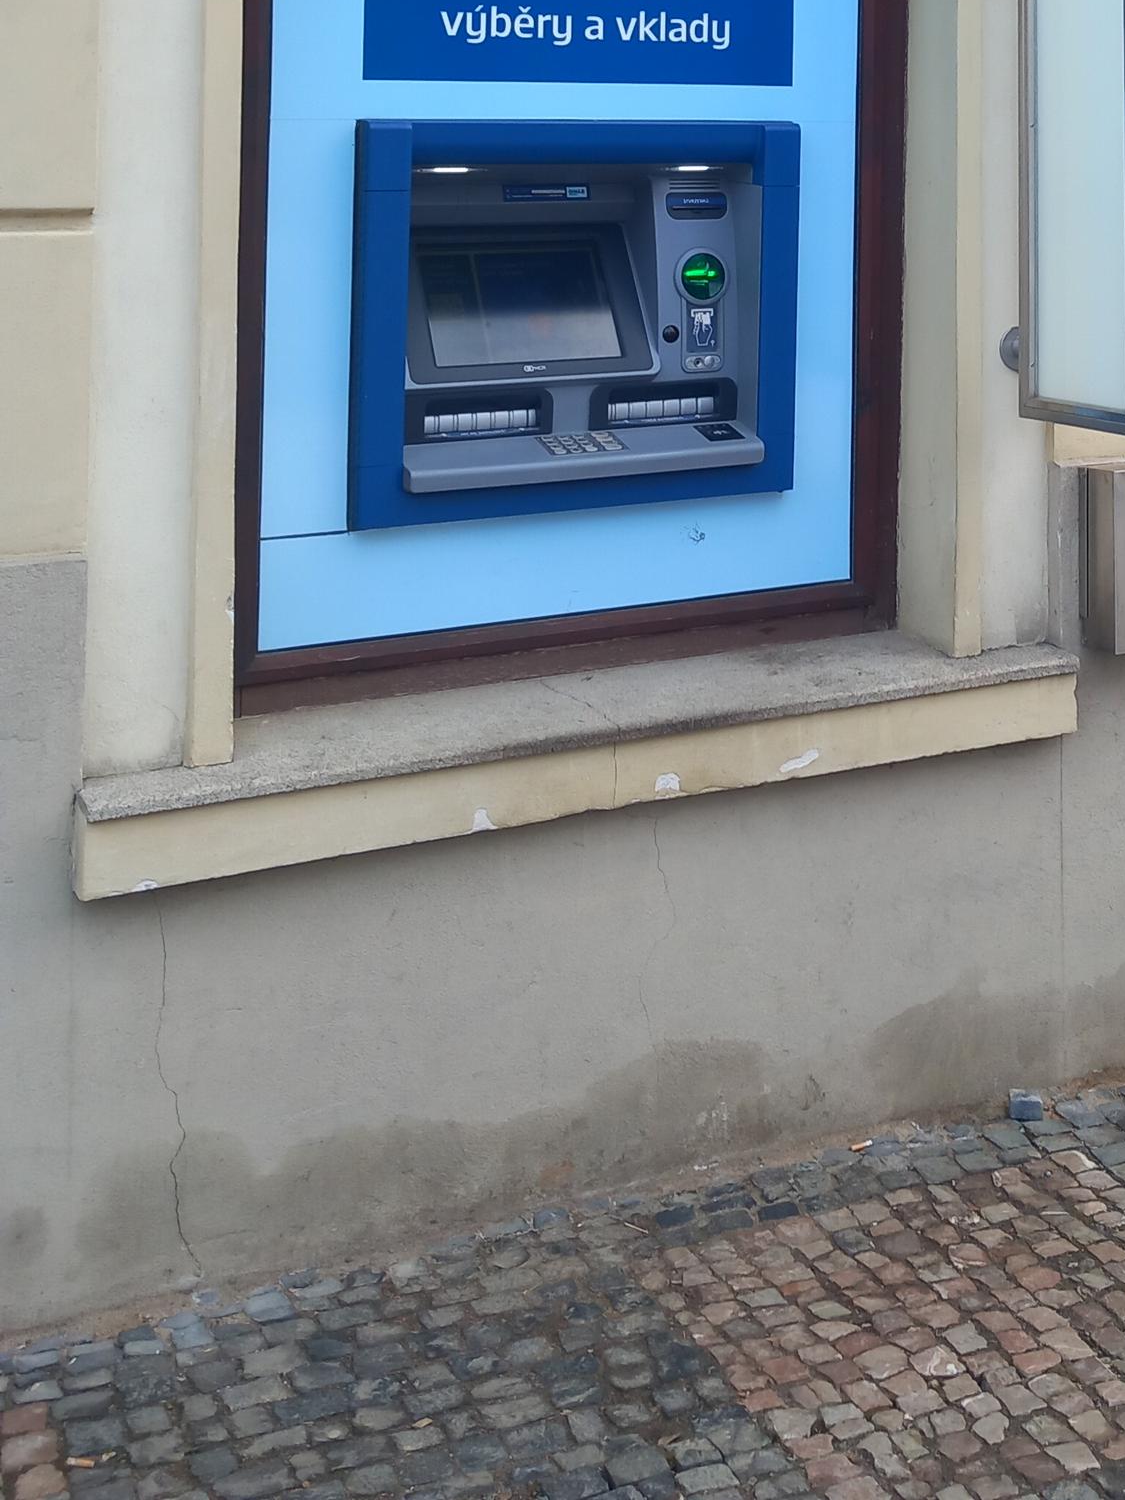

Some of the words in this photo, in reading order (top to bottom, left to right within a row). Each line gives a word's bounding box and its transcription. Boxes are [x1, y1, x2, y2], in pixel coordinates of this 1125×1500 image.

[440, 5, 573, 47] výběry
[584, 16, 604, 40] a
[616, 10, 731, 50] vklady
